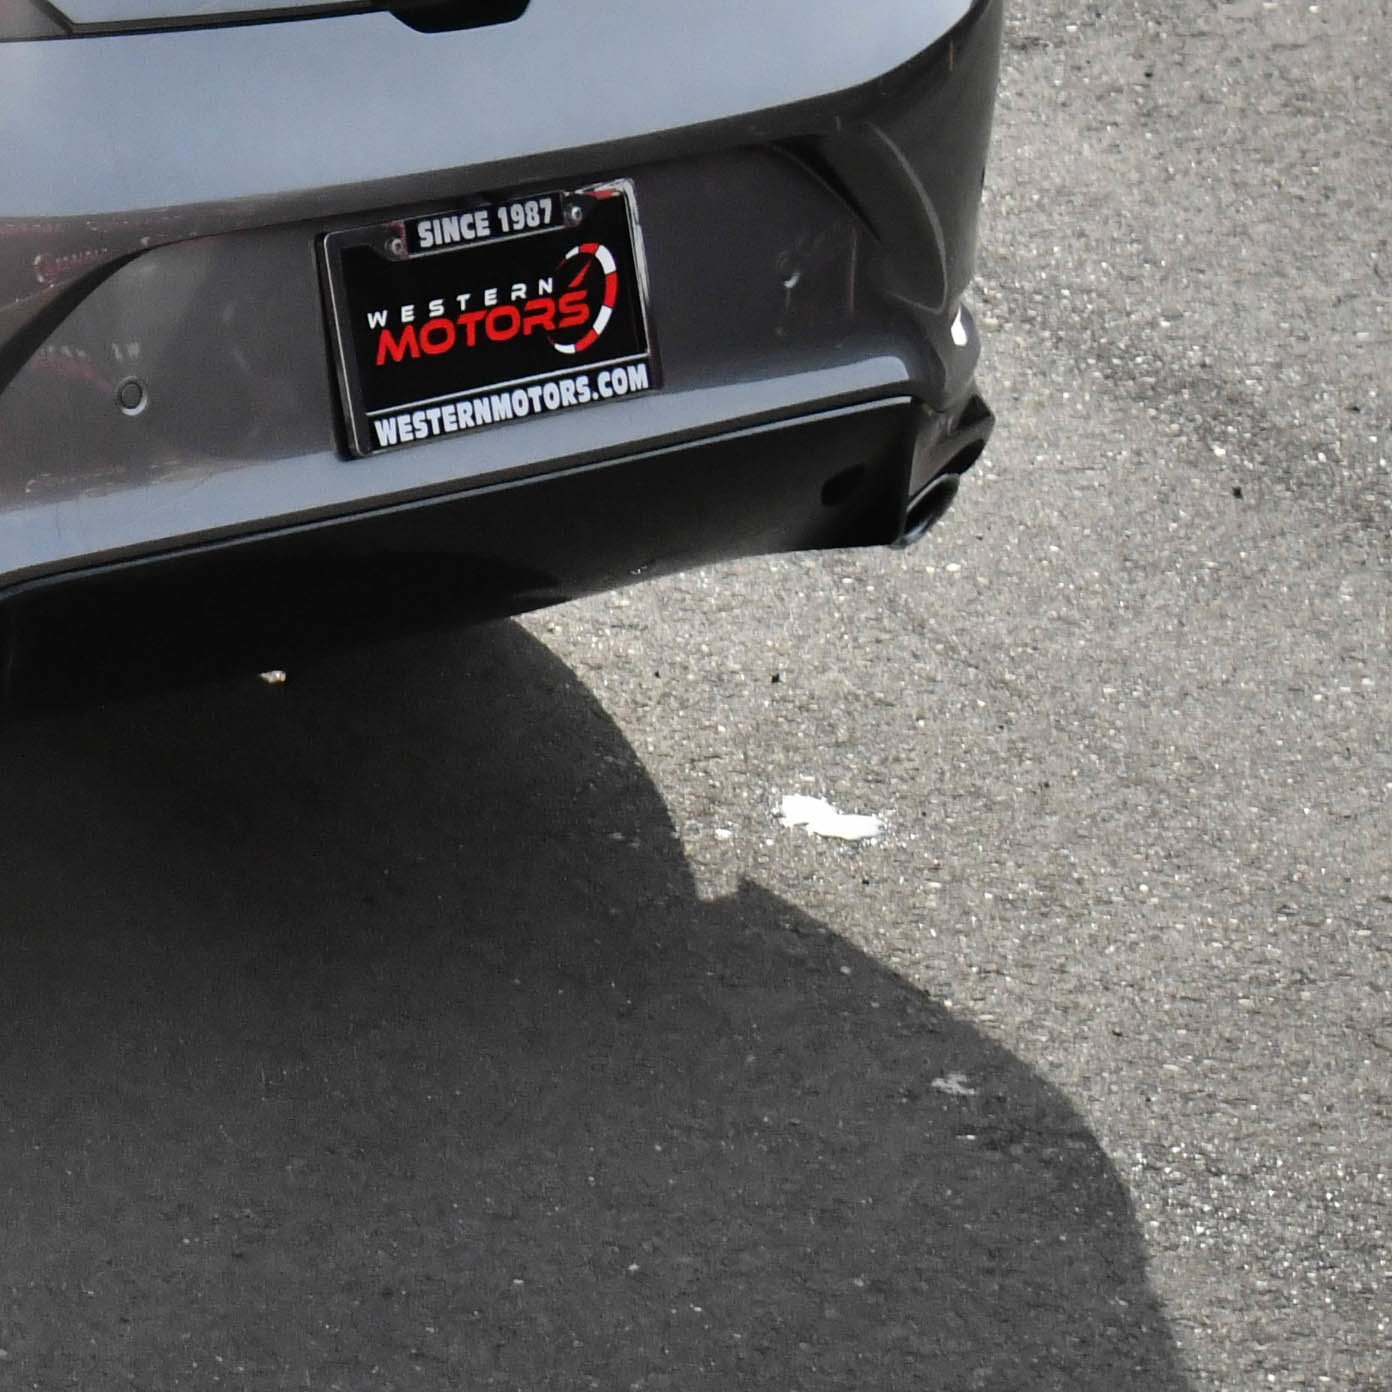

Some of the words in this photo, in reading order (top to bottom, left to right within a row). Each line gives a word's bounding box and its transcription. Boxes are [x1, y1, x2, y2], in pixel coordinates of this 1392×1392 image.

[417, 210, 491, 249] SINCE
[497, 198, 554, 234] 1987
[367, 277, 554, 330] WESTERN
[375, 290, 590, 367] MOTORS
[373, 363, 650, 448] WESTERNMOTORS.COM
